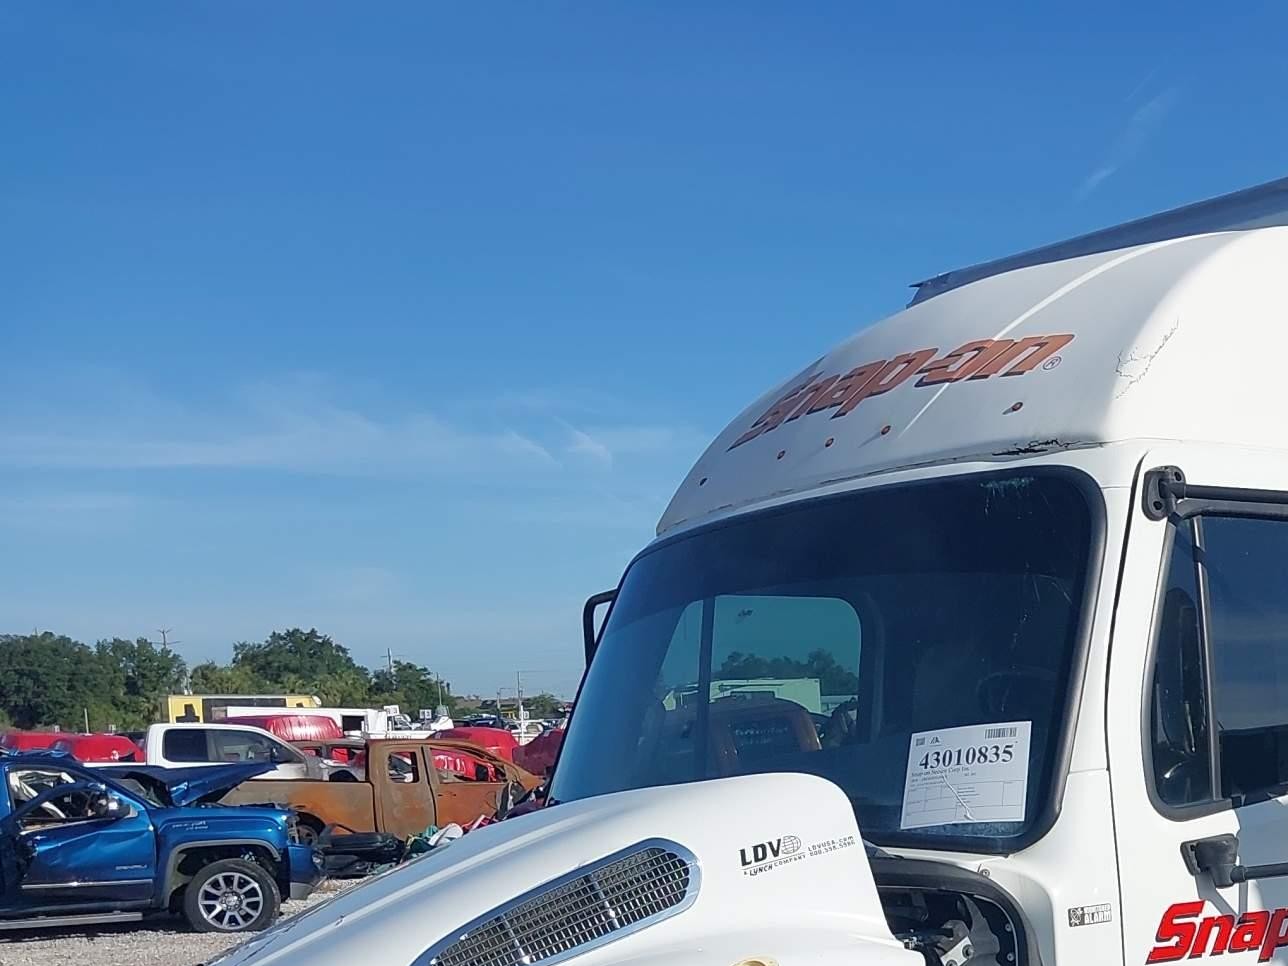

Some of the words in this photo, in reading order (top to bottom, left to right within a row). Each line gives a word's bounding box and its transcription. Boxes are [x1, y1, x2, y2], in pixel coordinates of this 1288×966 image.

[727, 333, 1075, 452] Snap-on
[919, 745, 1013, 769] 43010835
[739, 838, 782, 867] LDV
[749, 864, 773, 877] LYNCH
[1084, 911, 1112, 924] ALARM
